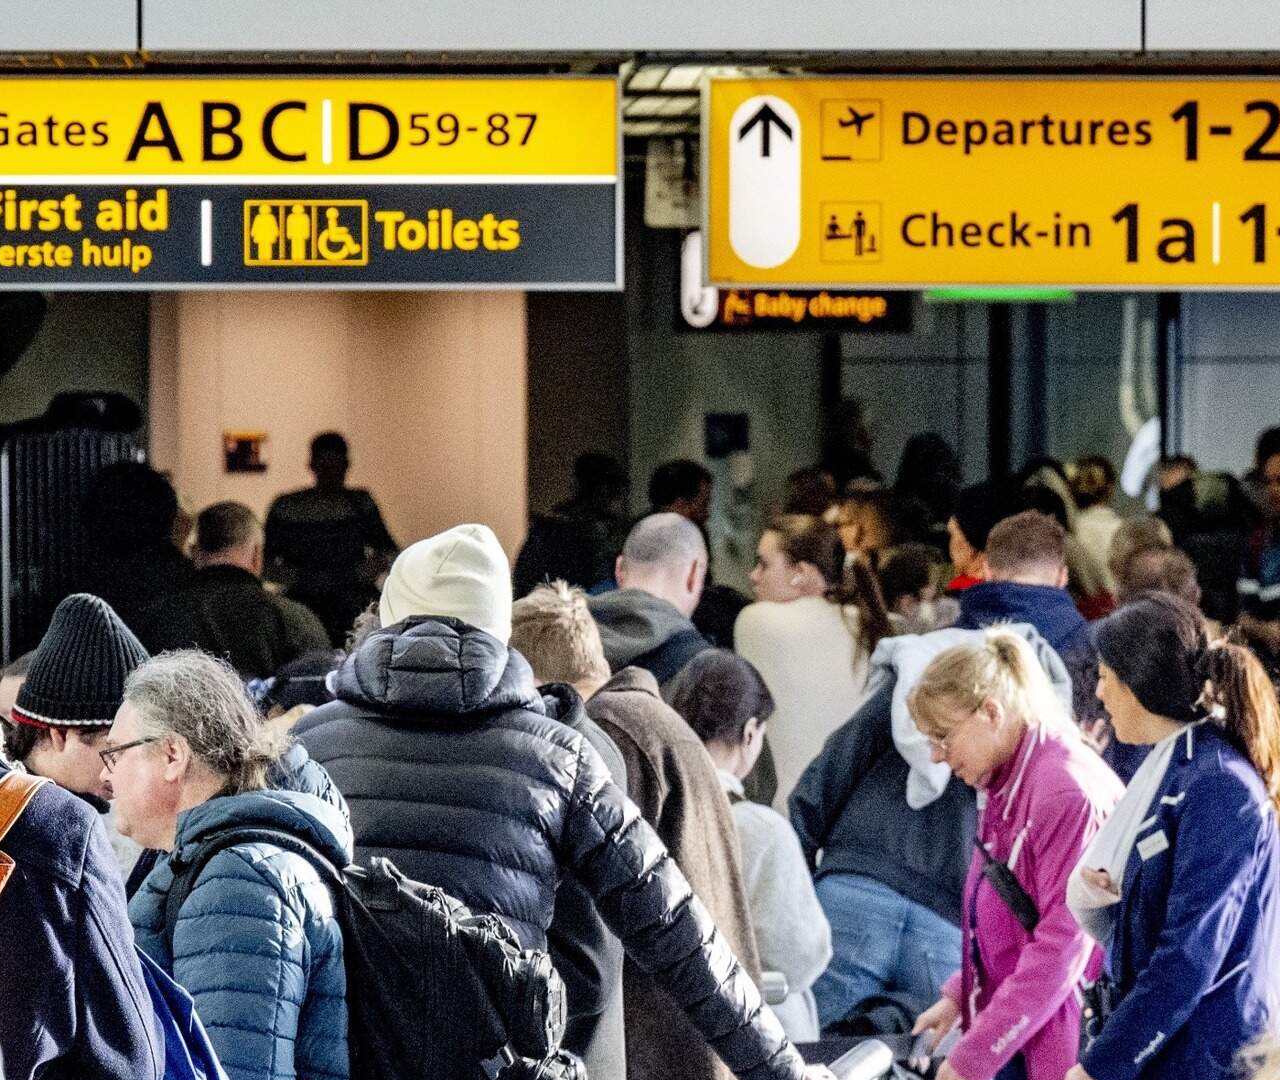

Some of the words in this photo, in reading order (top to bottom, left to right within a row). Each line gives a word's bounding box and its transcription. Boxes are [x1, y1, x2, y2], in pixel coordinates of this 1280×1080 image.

[126, 101, 184, 162] A
[202, 101, 244, 162] B
[260, 100, 308, 163] C
[902, 111, 1153, 155] Departures
[95, 188, 169, 232] aid
[374, 208, 521, 251] Toilets
[82, 237, 153, 274] hulp
[900, 211, 1091, 249] Check-in
[1112, 203, 1197, 264] 1a
[754, 291, 807, 323] Baby
[808, 289, 887, 323] change
